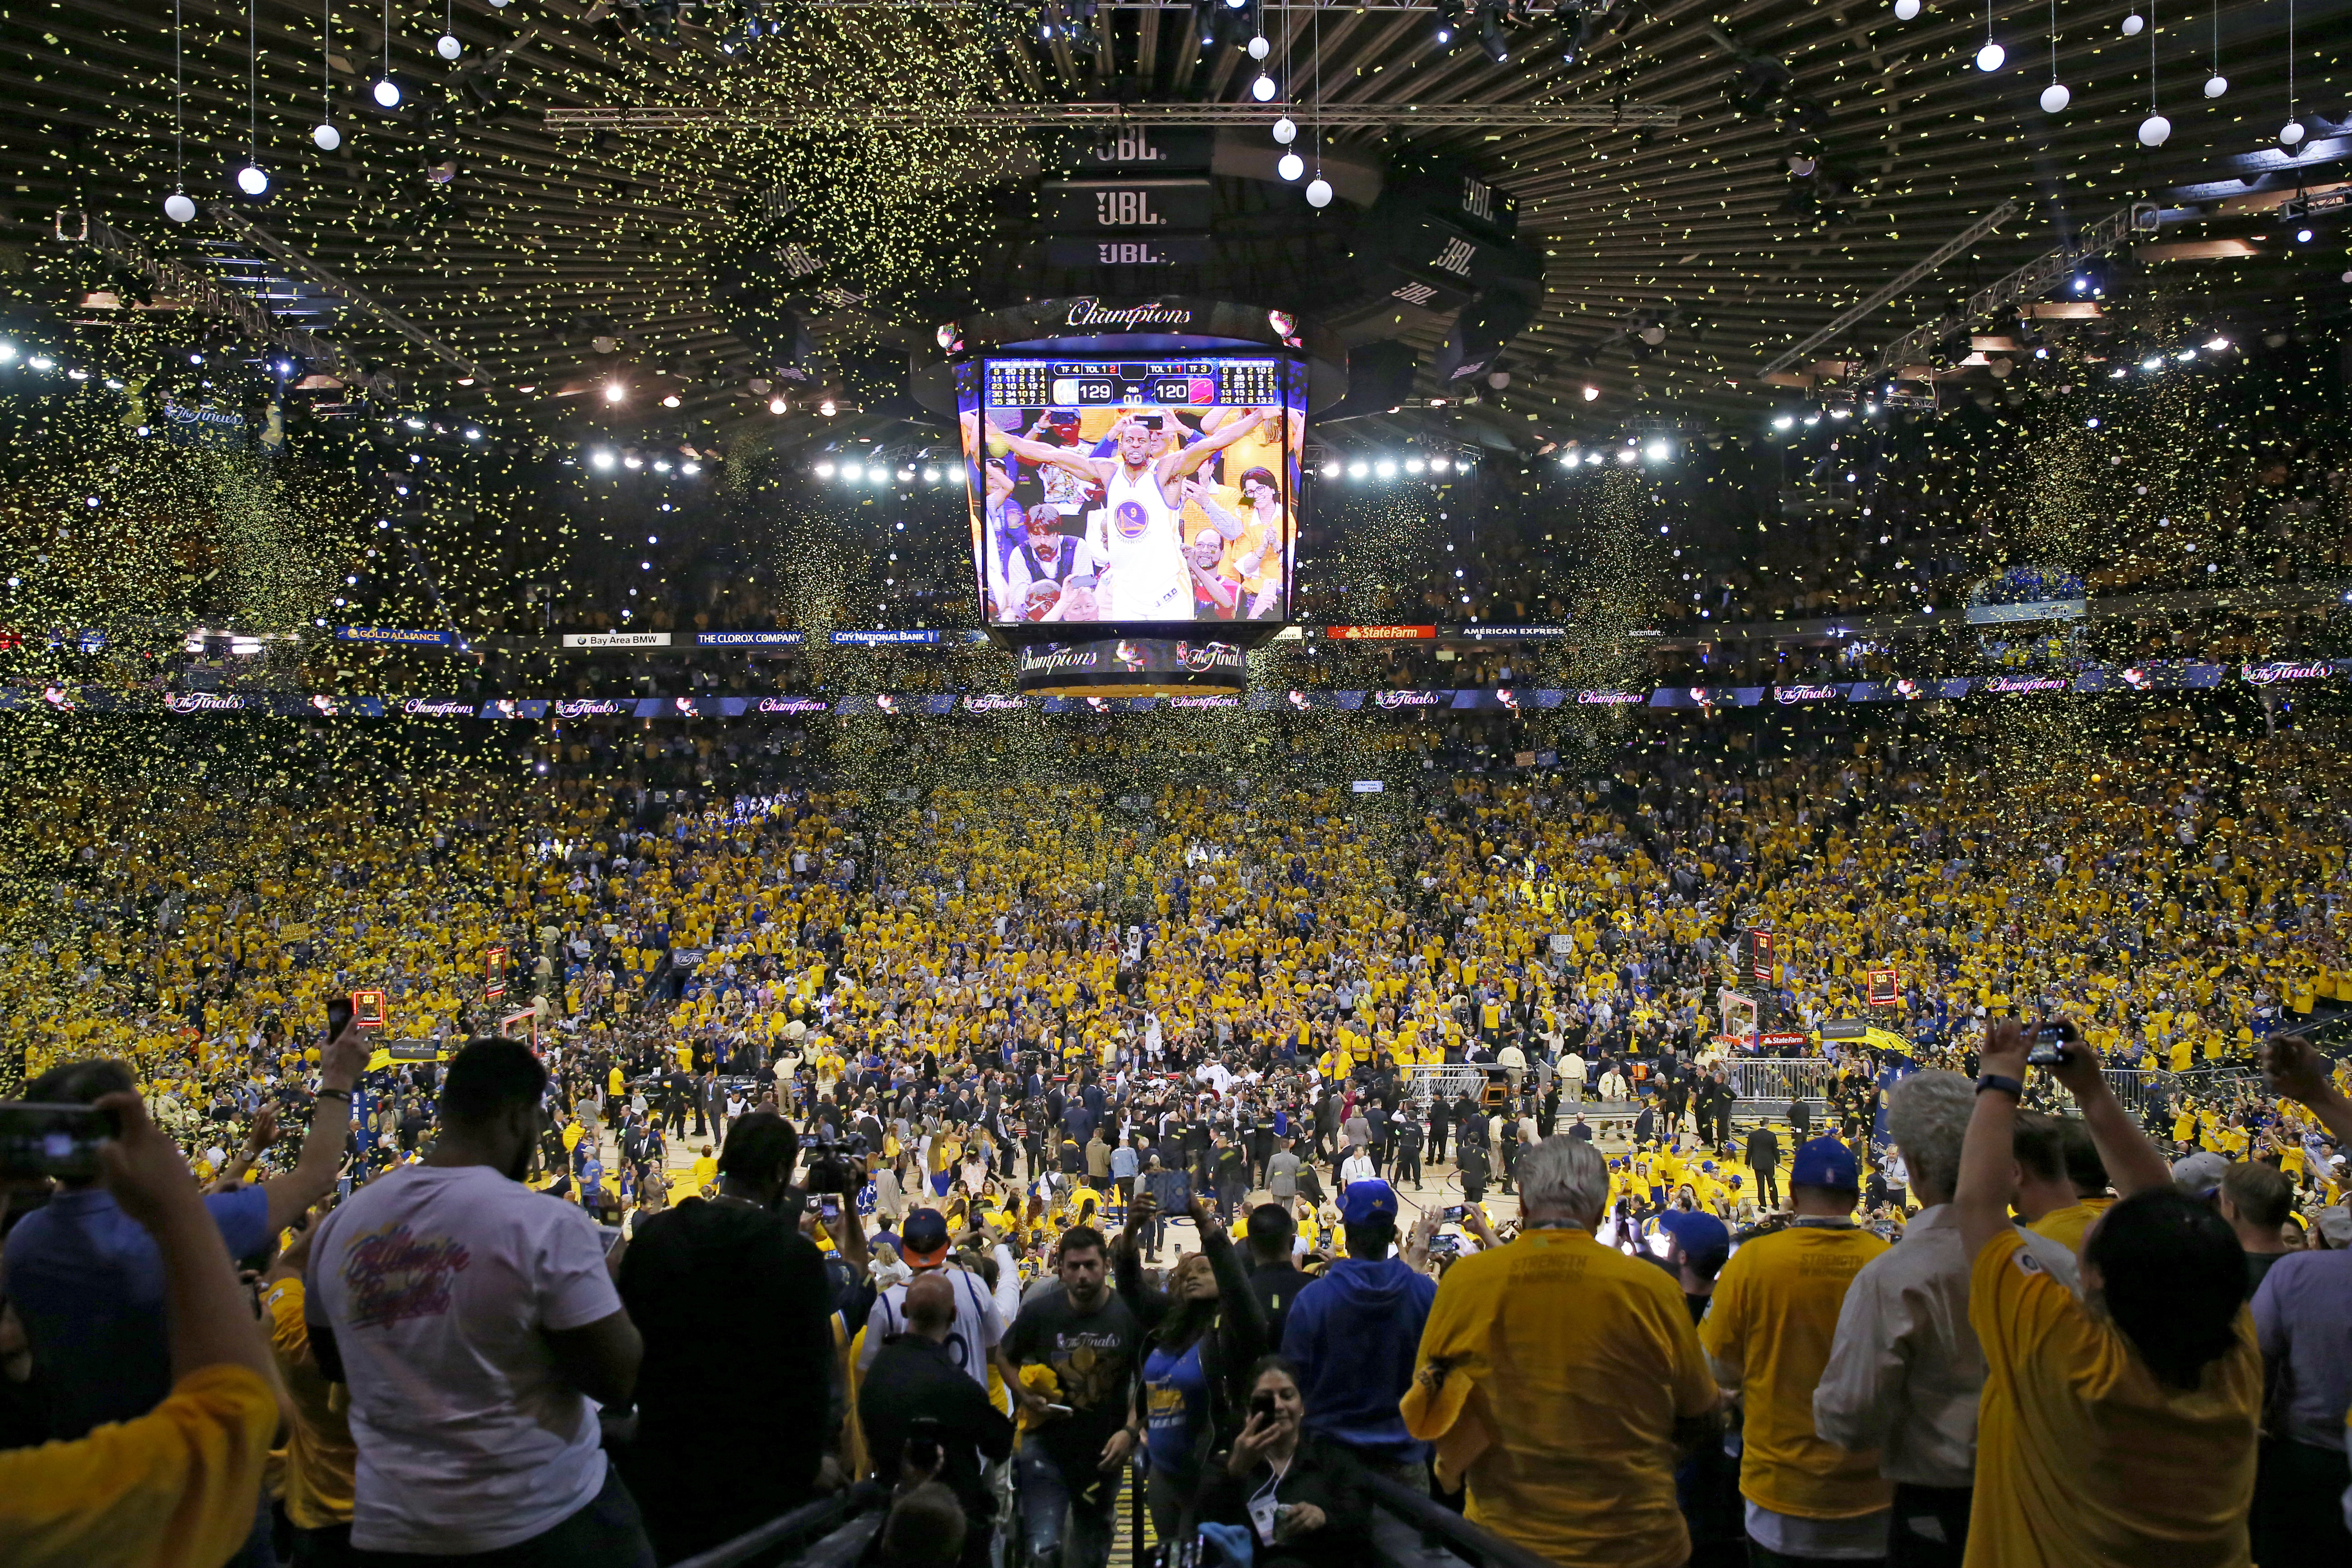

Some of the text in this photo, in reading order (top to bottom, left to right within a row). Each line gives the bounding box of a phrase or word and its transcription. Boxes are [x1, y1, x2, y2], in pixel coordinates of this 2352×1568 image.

[1462, 176, 1493, 222] JBL
[1096, 192, 1157, 225] JBL
[774, 242, 824, 278] JBL
[1098, 244, 1157, 264] JBL
[1436, 237, 1476, 276] JBL
[1392, 282, 1438, 305] JBL
[1068, 300, 1191, 330] Champions
[1109, 365, 1117, 373] 2
[1080, 385, 1111, 398] 129
[1156, 385, 1187, 398] 120
[1123, 395, 1142, 404] 0.0
[1130, 507, 1137, 518] 9
[1117, 530, 1151, 544] WARRIORS
[360, 630, 440, 642] GOLD ALLIANCE
[699, 633, 800, 643] THE CLOROX COMPANY
[856, 633, 899, 642] NATIONAL
[900, 633, 925, 641] BANK
[1021, 646, 1097, 676] Champions
[2254, 662, 2328, 681] The Finals
[1384, 690, 1435, 705] The Finals
[1578, 690, 1644, 706] Champions
[1782, 685, 1833, 700] The Finals
[175, 692, 241, 709] The Finals
[405, 699, 474, 717] Champions
[565, 699, 615, 714] The Finals
[759, 697, 827, 715] Champions
[971, 694, 1024, 709] The Finals
[1877, 975, 1887, 983] 0.0
[363, 995, 374, 1004] 0.0
[1894, 1036, 1910, 1049] SPALDING
[1221, 1073, 1224, 1083] 1
[1511, 1254, 1588, 1271] STRENGTH
[1800, 1254, 1864, 1267] STRENGTH
[1080, 1333, 1116, 1348] Finals
